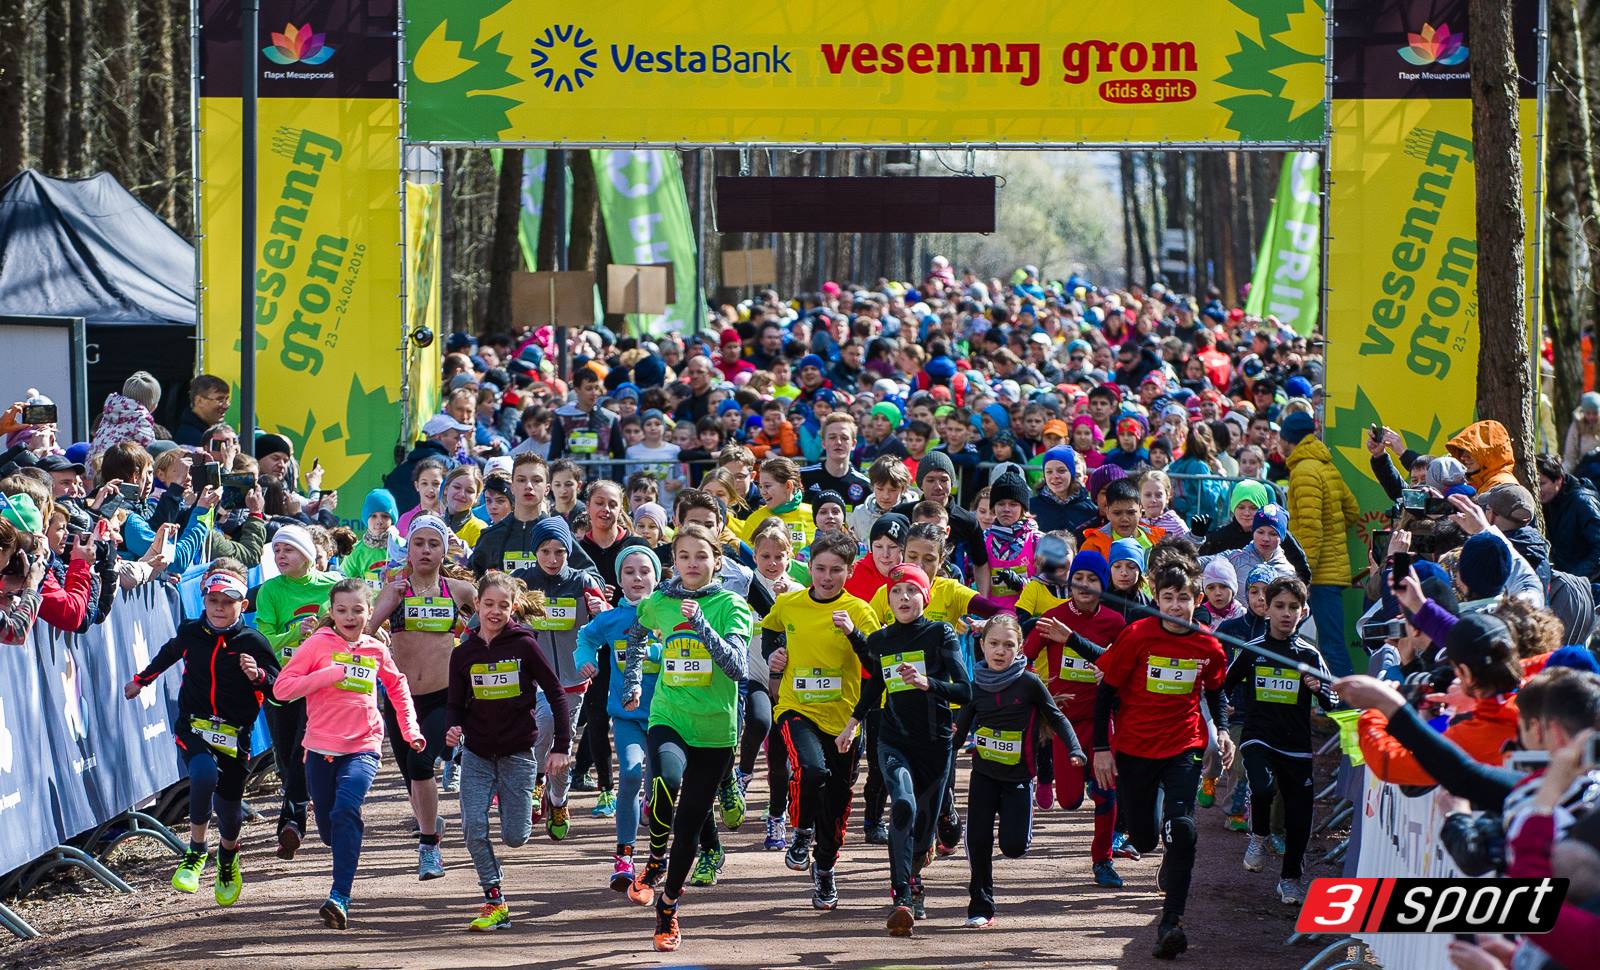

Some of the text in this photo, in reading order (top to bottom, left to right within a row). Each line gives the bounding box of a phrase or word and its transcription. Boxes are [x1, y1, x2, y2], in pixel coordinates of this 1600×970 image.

[1062, 40, 1198, 85] grom
[264, 71, 335, 80] Парк Мещерский
[1398, 71, 1471, 81] Парк Мещерский
[1105, 82, 1191, 101] kids & girls
[325, 332, 338, 349] 23
[336, 242, 366, 315] 24.04.2016
[279, 234, 350, 376] grom
[1406, 236, 1478, 381] grom
[1453, 336, 1466, 353] 23
[792, 532, 803, 540] 93
[551, 608, 566, 617] 53
[684, 661, 700, 671] 28
[351, 666, 370, 678] 197
[1174, 670, 1183, 680] 2
[491, 674, 508, 685] 75
[816, 679, 831, 689] 12
[1271, 679, 1293, 690] 110
[211, 733, 227, 745] 62
[992, 740, 1014, 752] 198
